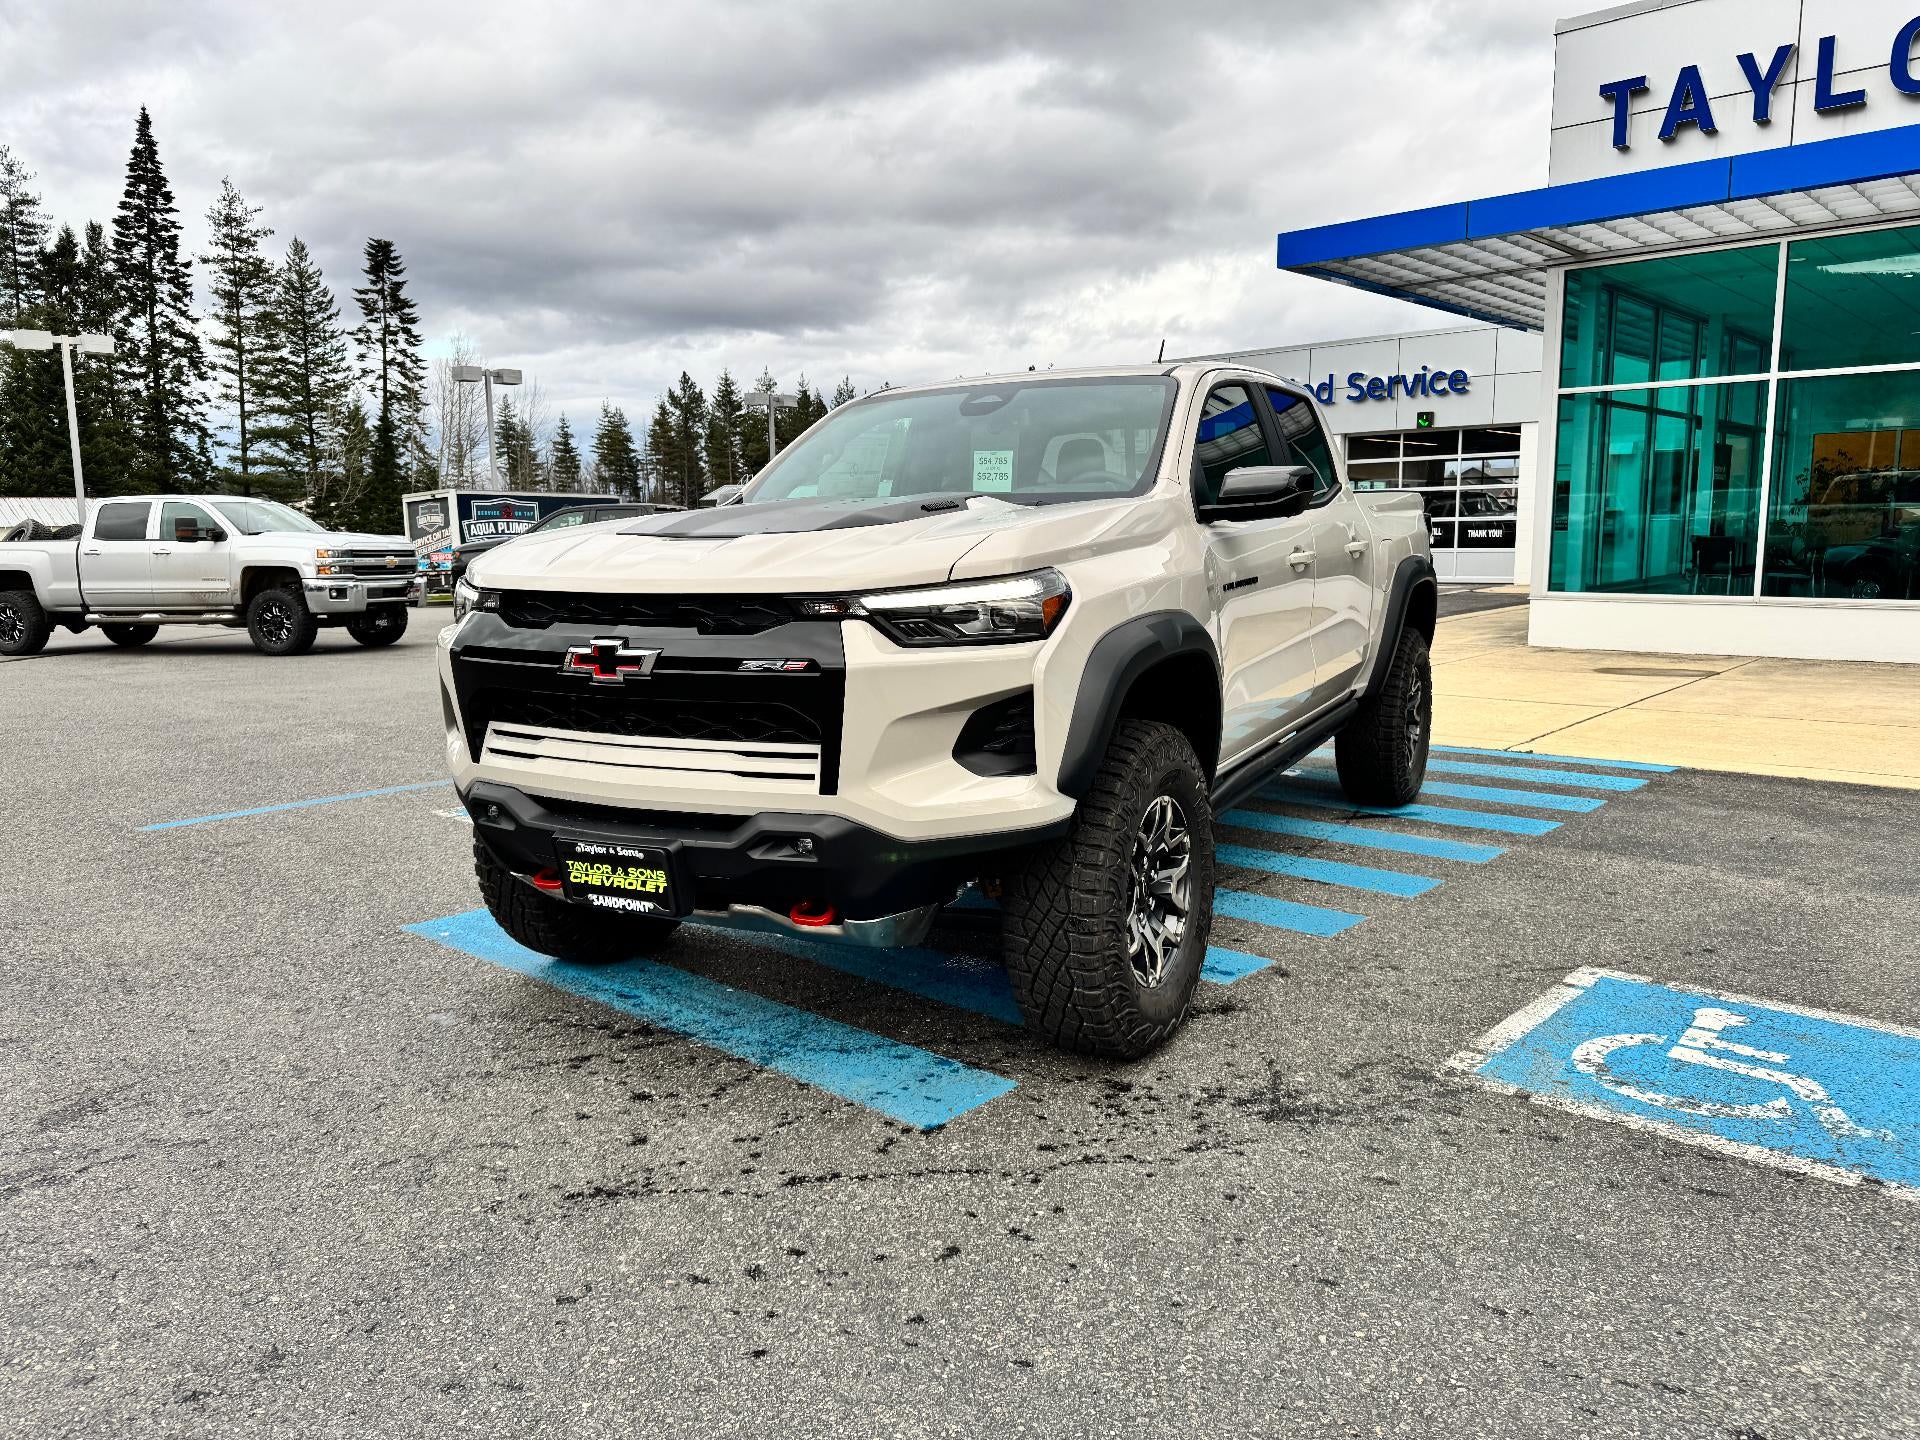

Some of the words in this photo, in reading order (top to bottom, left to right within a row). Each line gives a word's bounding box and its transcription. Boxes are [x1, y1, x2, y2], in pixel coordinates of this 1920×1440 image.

[1346, 365, 1470, 401] Service
[470, 522, 496, 536] AQUA
[1468, 529, 1487, 538] THANK
[1488, 529, 1503, 538] YOU!
[578, 843, 607, 855] Taylor
[617, 847, 639, 857] Sons
[566, 860, 612, 875] TAYLOR
[615, 867, 625, 877] &
[628, 867, 667, 880] SONS
[570, 872, 668, 894] CHEVROLET
[592, 894, 651, 912] SANDPOINT
